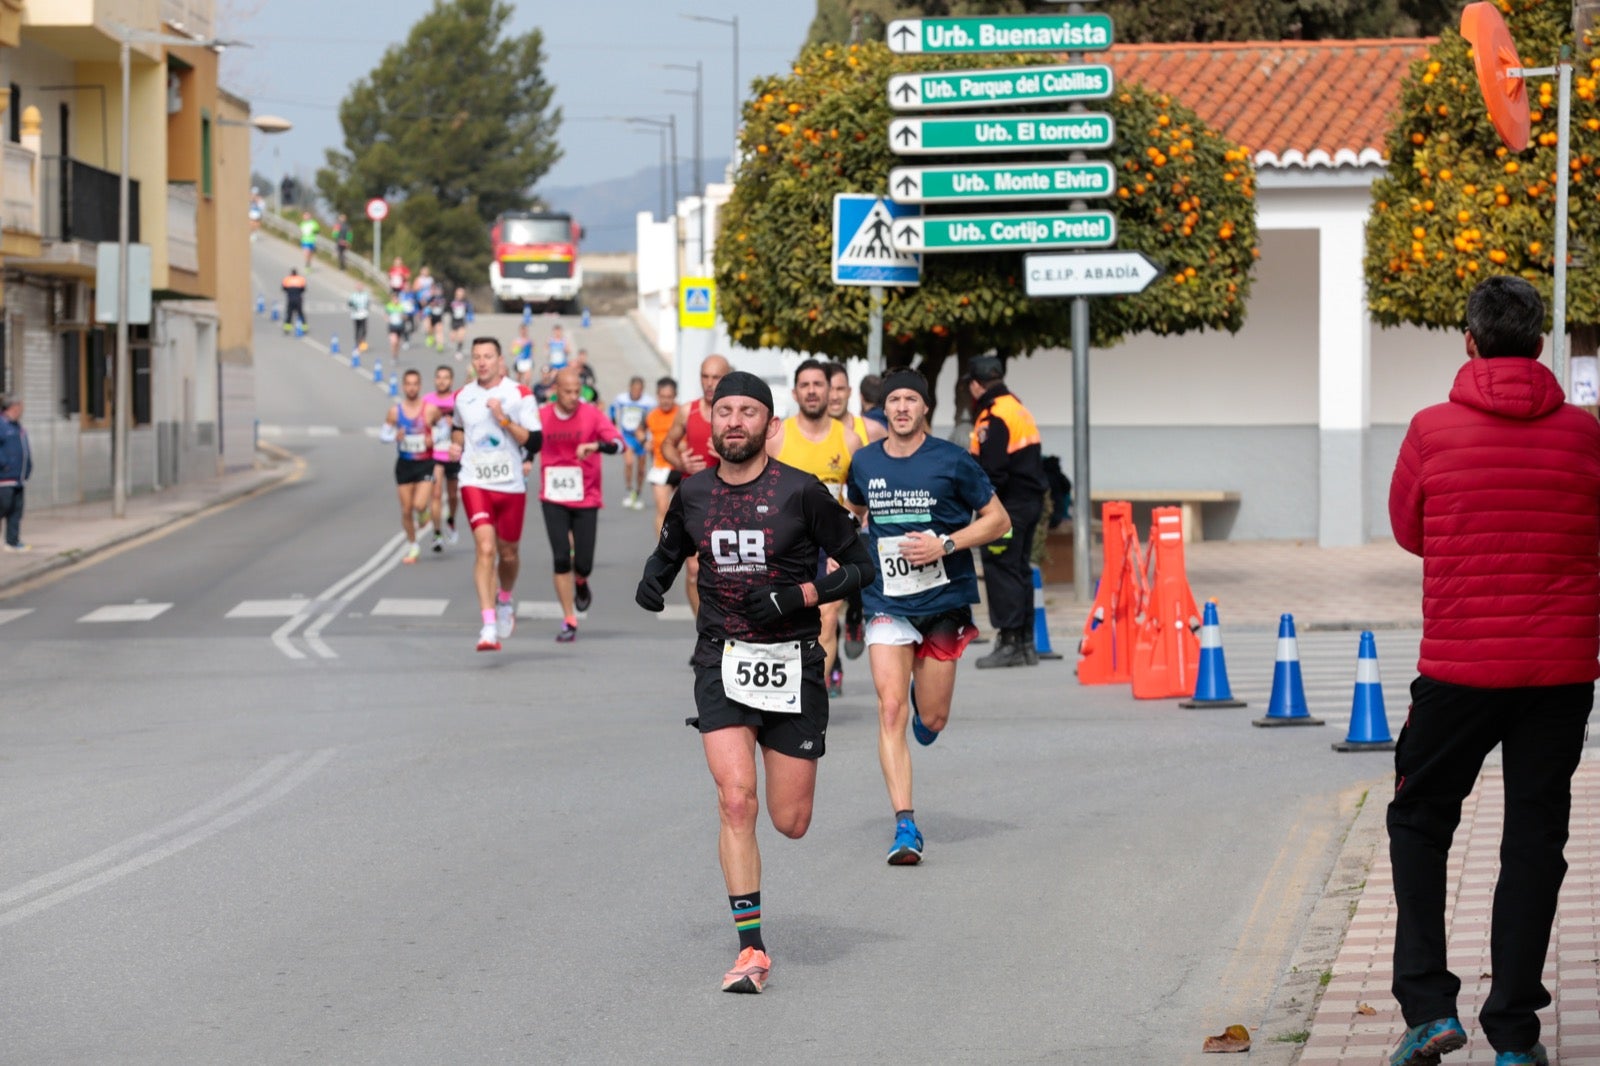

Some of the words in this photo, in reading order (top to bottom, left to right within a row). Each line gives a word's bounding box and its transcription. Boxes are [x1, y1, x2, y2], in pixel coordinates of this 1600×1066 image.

[926, 25, 974, 48] Urb.
[979, 22, 1107, 46] Buenavista
[924, 80, 957, 99] Urb.
[960, 78, 1013, 98] Parque
[1016, 75, 1040, 93] del
[1043, 72, 1103, 92] Cubillas
[975, 122, 1013, 142] Urb.
[1017, 122, 1035, 141] El
[1039, 120, 1103, 140] torreón
[952, 174, 990, 192] Urb.
[994, 172, 1050, 191] Monte
[1054, 170, 1103, 189] Elvira
[949, 223, 985, 242] Urb.
[990, 221, 1049, 243] Cortijo
[1052, 218, 1105, 238] Pretel
[1084, 264, 1140, 279] ABADÍA
[475, 463, 510, 480] 3050
[868, 490, 892, 499] Medio
[894, 488, 930, 498] Maratón
[869, 498, 903, 509] Almería
[711, 530, 766, 565] CB
[735, 661, 787, 688] 585
